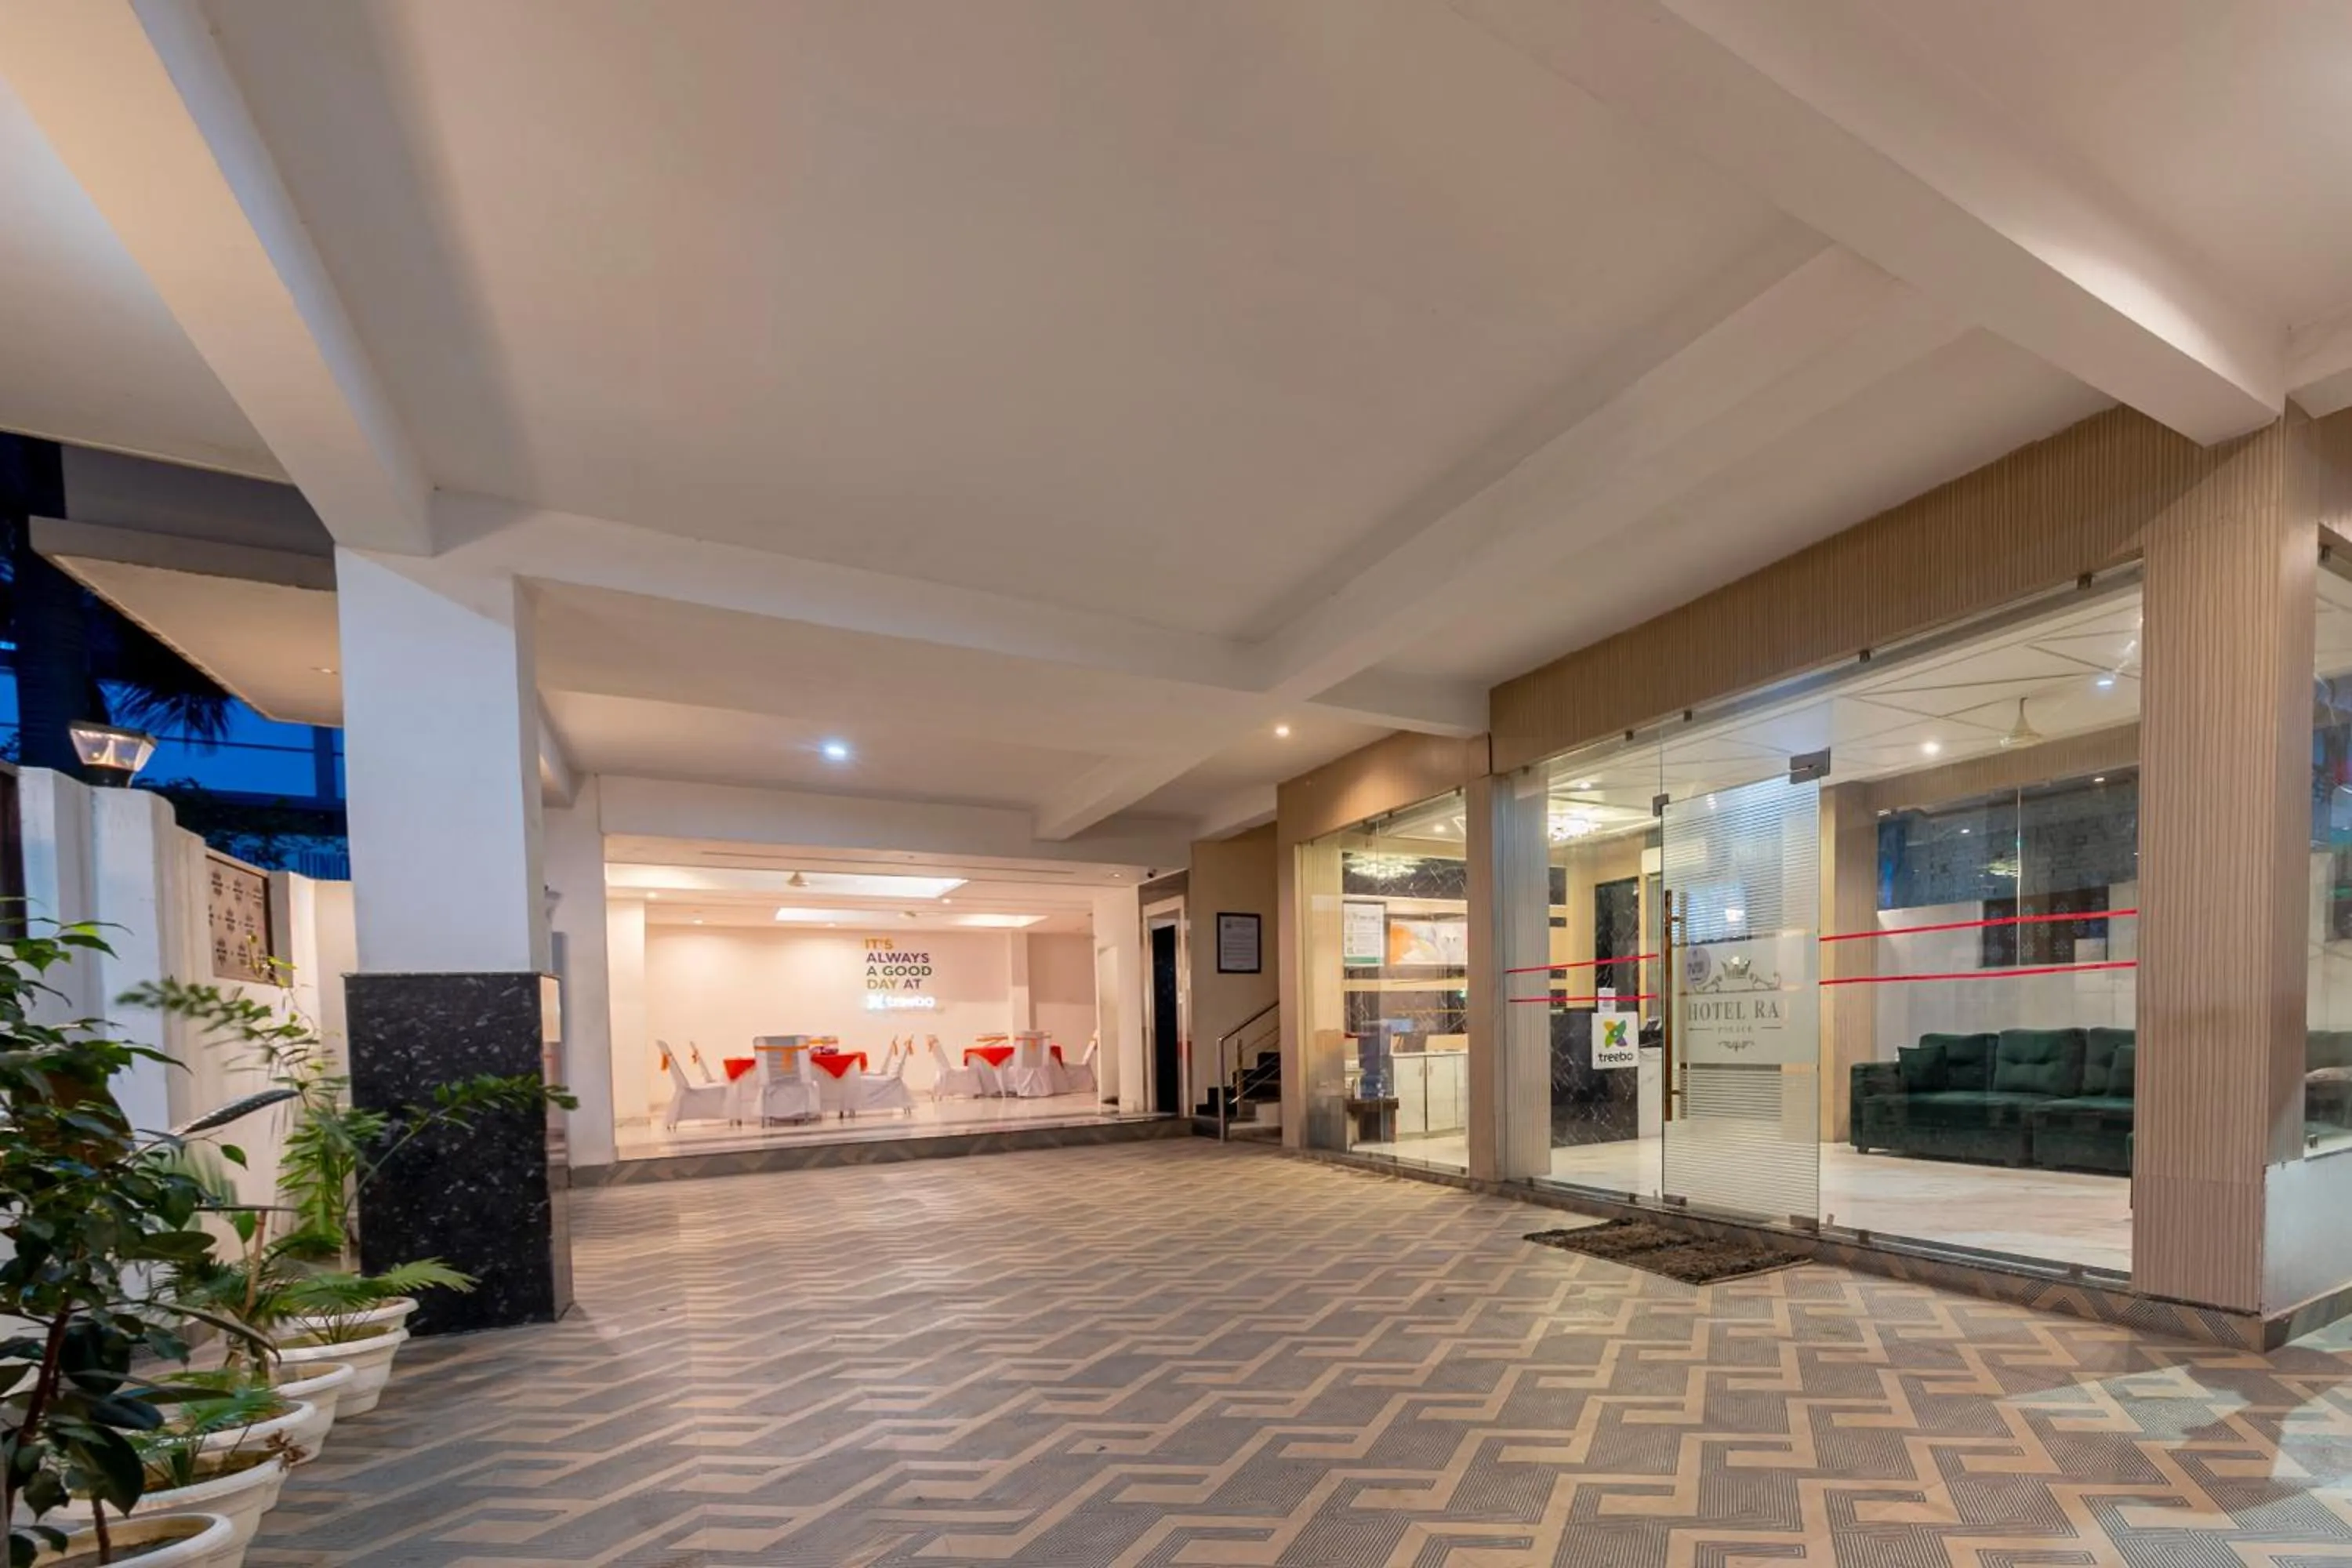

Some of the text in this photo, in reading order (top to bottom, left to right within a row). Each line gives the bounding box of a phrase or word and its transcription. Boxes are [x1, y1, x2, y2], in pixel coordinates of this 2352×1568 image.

[865, 938, 893, 949] IT'S
[866, 953, 930, 963] ALWAYS
[866, 965, 932, 976] A GOOD
[867, 978, 921, 989] DAY AT
[1688, 1000, 1746, 1022] HOTEL
[1598, 1051, 1633, 1063] treebo
